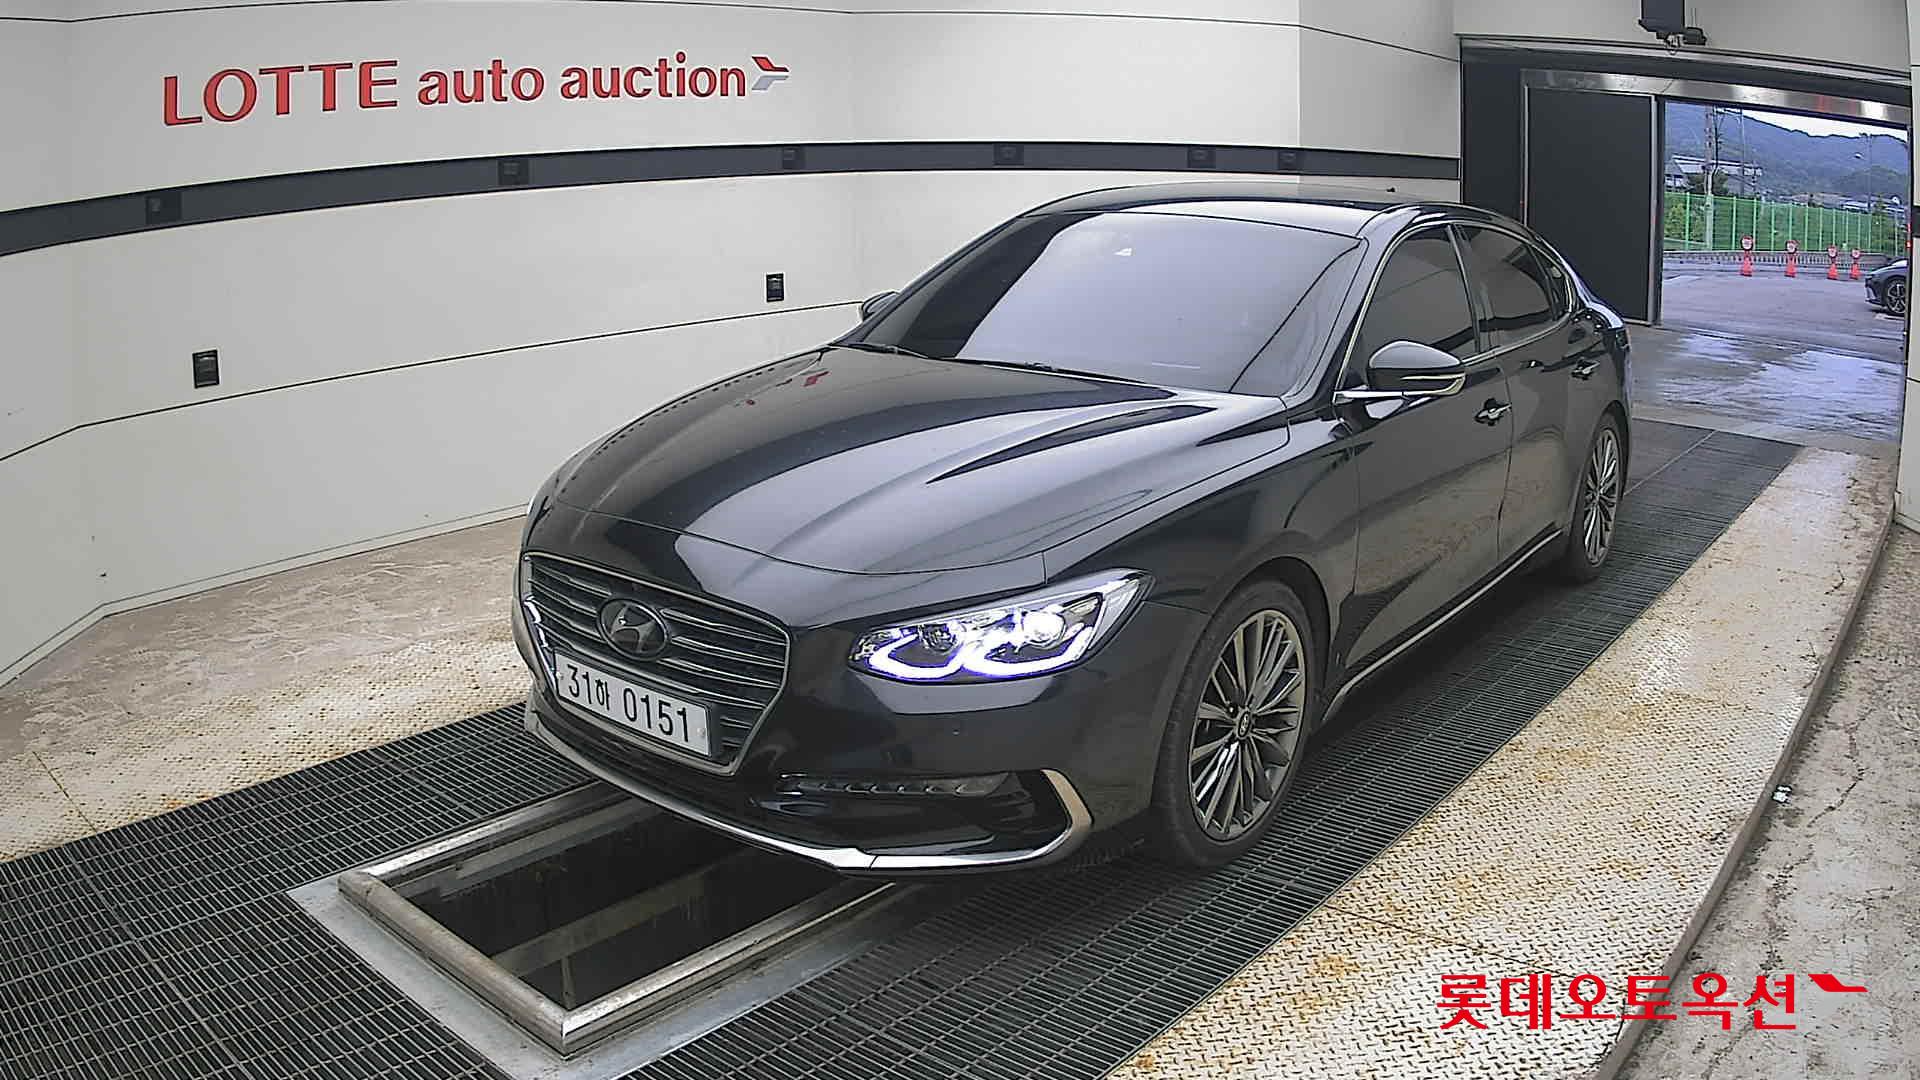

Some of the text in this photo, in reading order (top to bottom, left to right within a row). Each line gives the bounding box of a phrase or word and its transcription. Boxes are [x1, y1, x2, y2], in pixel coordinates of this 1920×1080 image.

[163, 51, 747, 126] LOTTE auto auction
[567, 663, 689, 742] 31하 0151
